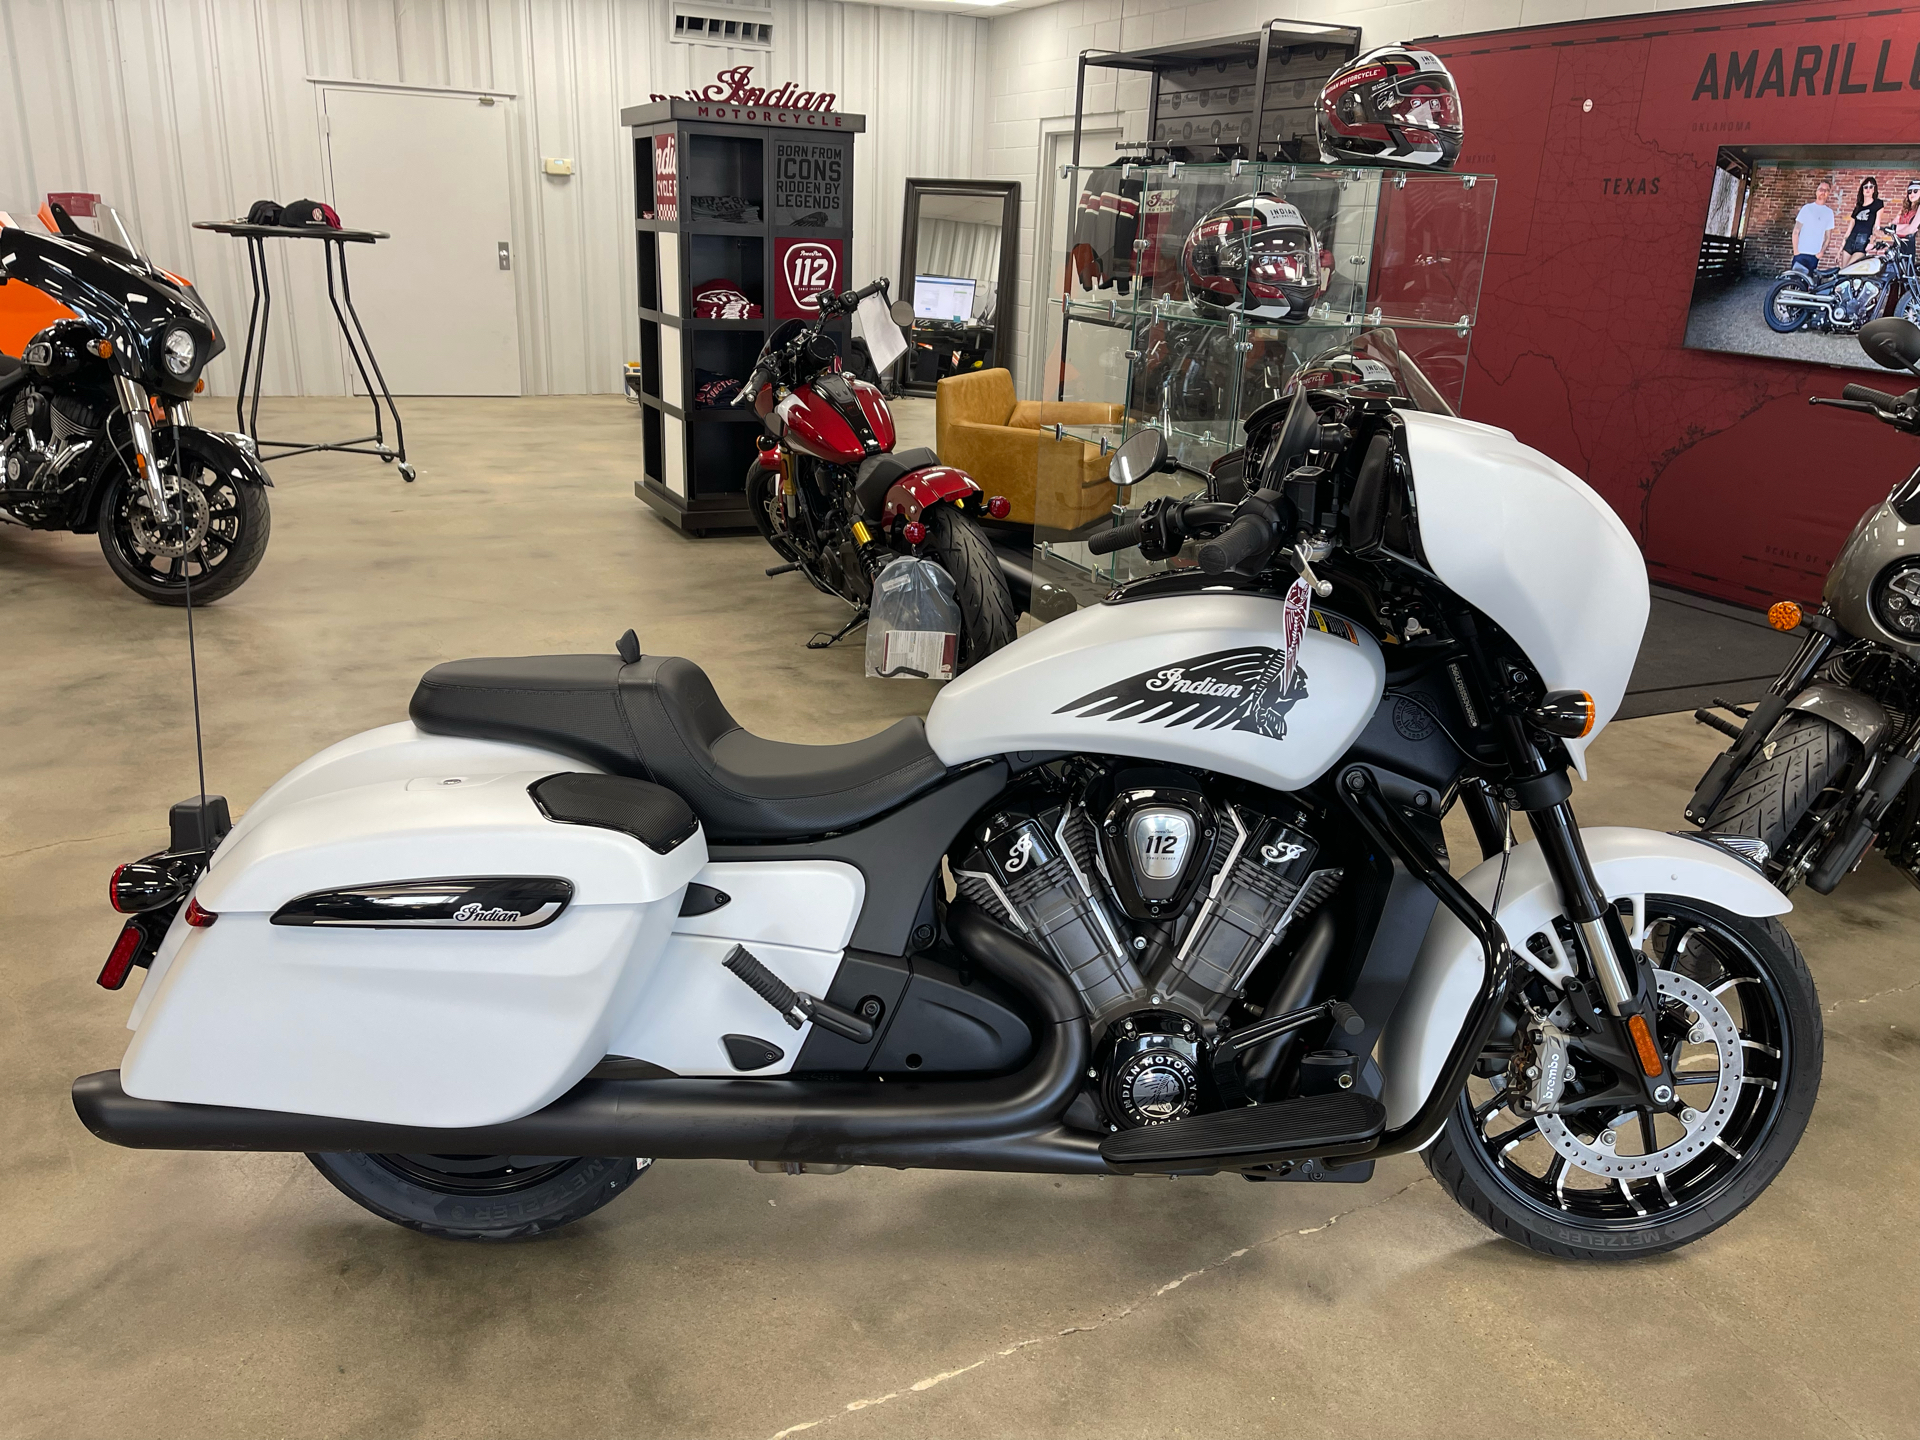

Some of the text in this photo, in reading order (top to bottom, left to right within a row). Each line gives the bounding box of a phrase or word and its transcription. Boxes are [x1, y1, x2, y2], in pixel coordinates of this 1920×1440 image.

[1340, 69, 1379, 86] MOTORCYCLE
[703, 66, 836, 112] Indian
[698, 106, 842, 127] MOTORCYCLE
[1691, 121, 1751, 133] OKLAHOMA
[777, 145, 842, 160] BORN FROM
[1466, 154, 1496, 164] MEXICO
[776, 158, 841, 182] ICONS
[776, 181, 840, 195] RIDDEN BY
[1603, 177, 1661, 196] TEXAS
[776, 194, 840, 209] LEGENDS
[1270, 208, 1297, 216] INDIAN
[793, 258, 829, 286] 112
[1765, 545, 1800, 560] SCALE
[1145, 668, 1244, 699] Indian
[1145, 835, 1178, 854] 112
[452, 903, 520, 924] Indian
[1122, 1056, 1198, 1115] INDIAN MOTORCYCLE
[1543, 1053, 1560, 1099] brembo
[474, 1158, 606, 1222] METZELER
[1558, 1230, 1661, 1247] METZELER
